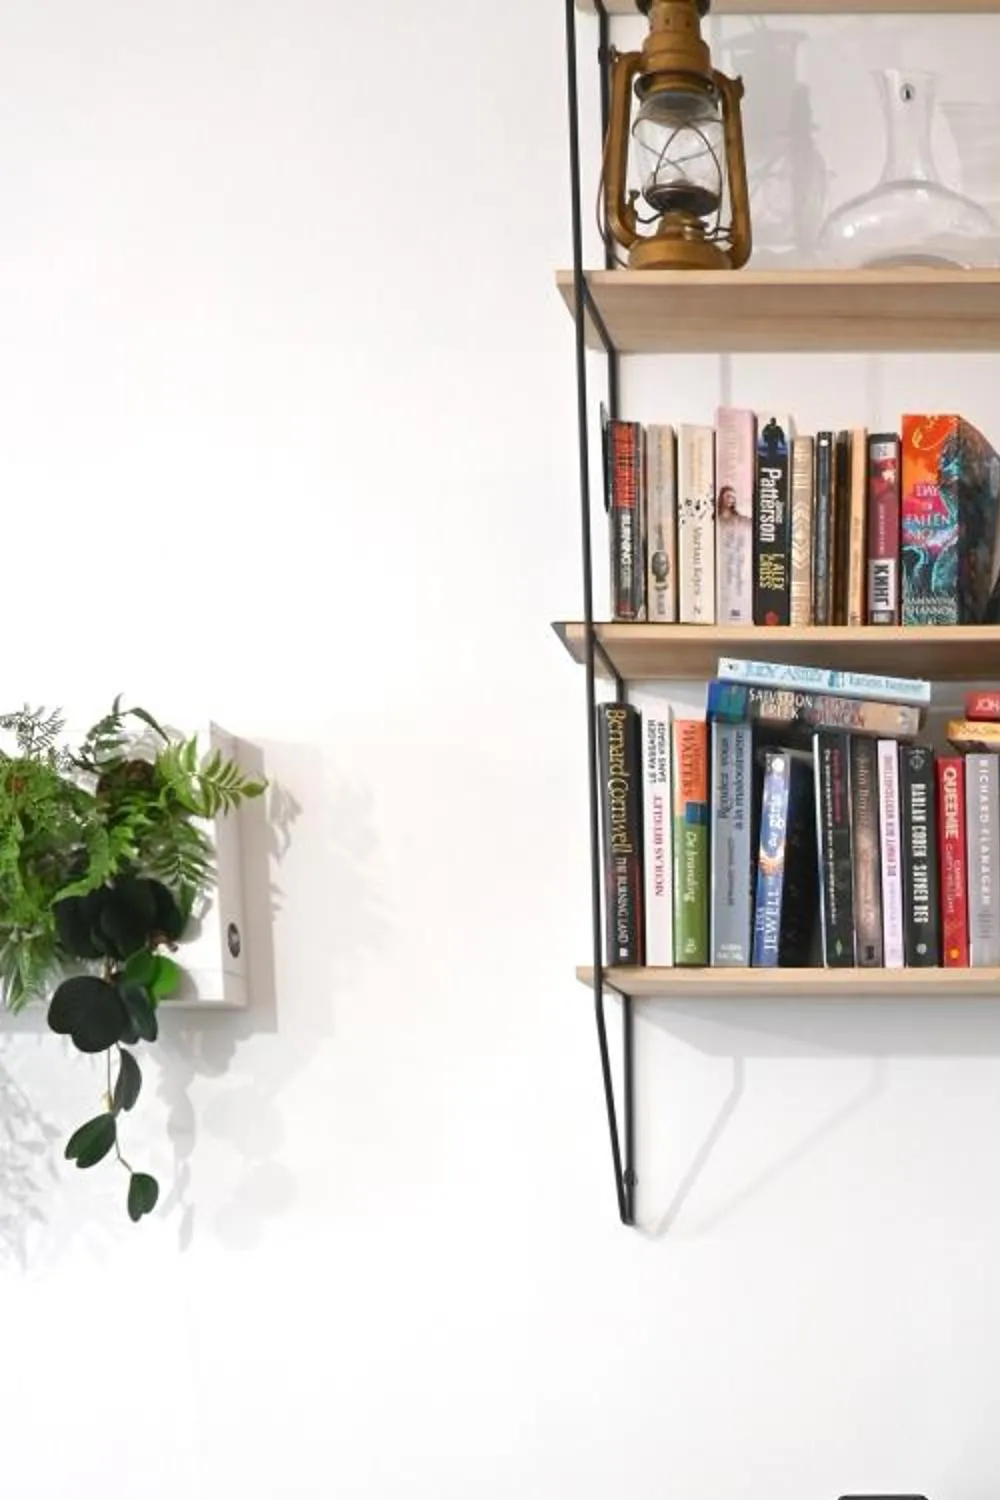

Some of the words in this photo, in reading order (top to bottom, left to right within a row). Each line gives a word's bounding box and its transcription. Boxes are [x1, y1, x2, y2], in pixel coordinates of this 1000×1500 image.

[760, 467, 782, 542] Patterson
[873, 564, 889, 605] КИНГ
[606, 708, 630, 775] Bernard
[608, 777, 632, 854] Cornwell
[911, 783, 926, 824] HARLAN
[943, 767, 958, 840] QUEENIE
[979, 759, 990, 822] RICHARD
[912, 825, 926, 857] COBEN
[980, 828, 992, 905] FLANAGAN
[764, 888, 779, 952] JEWELL
